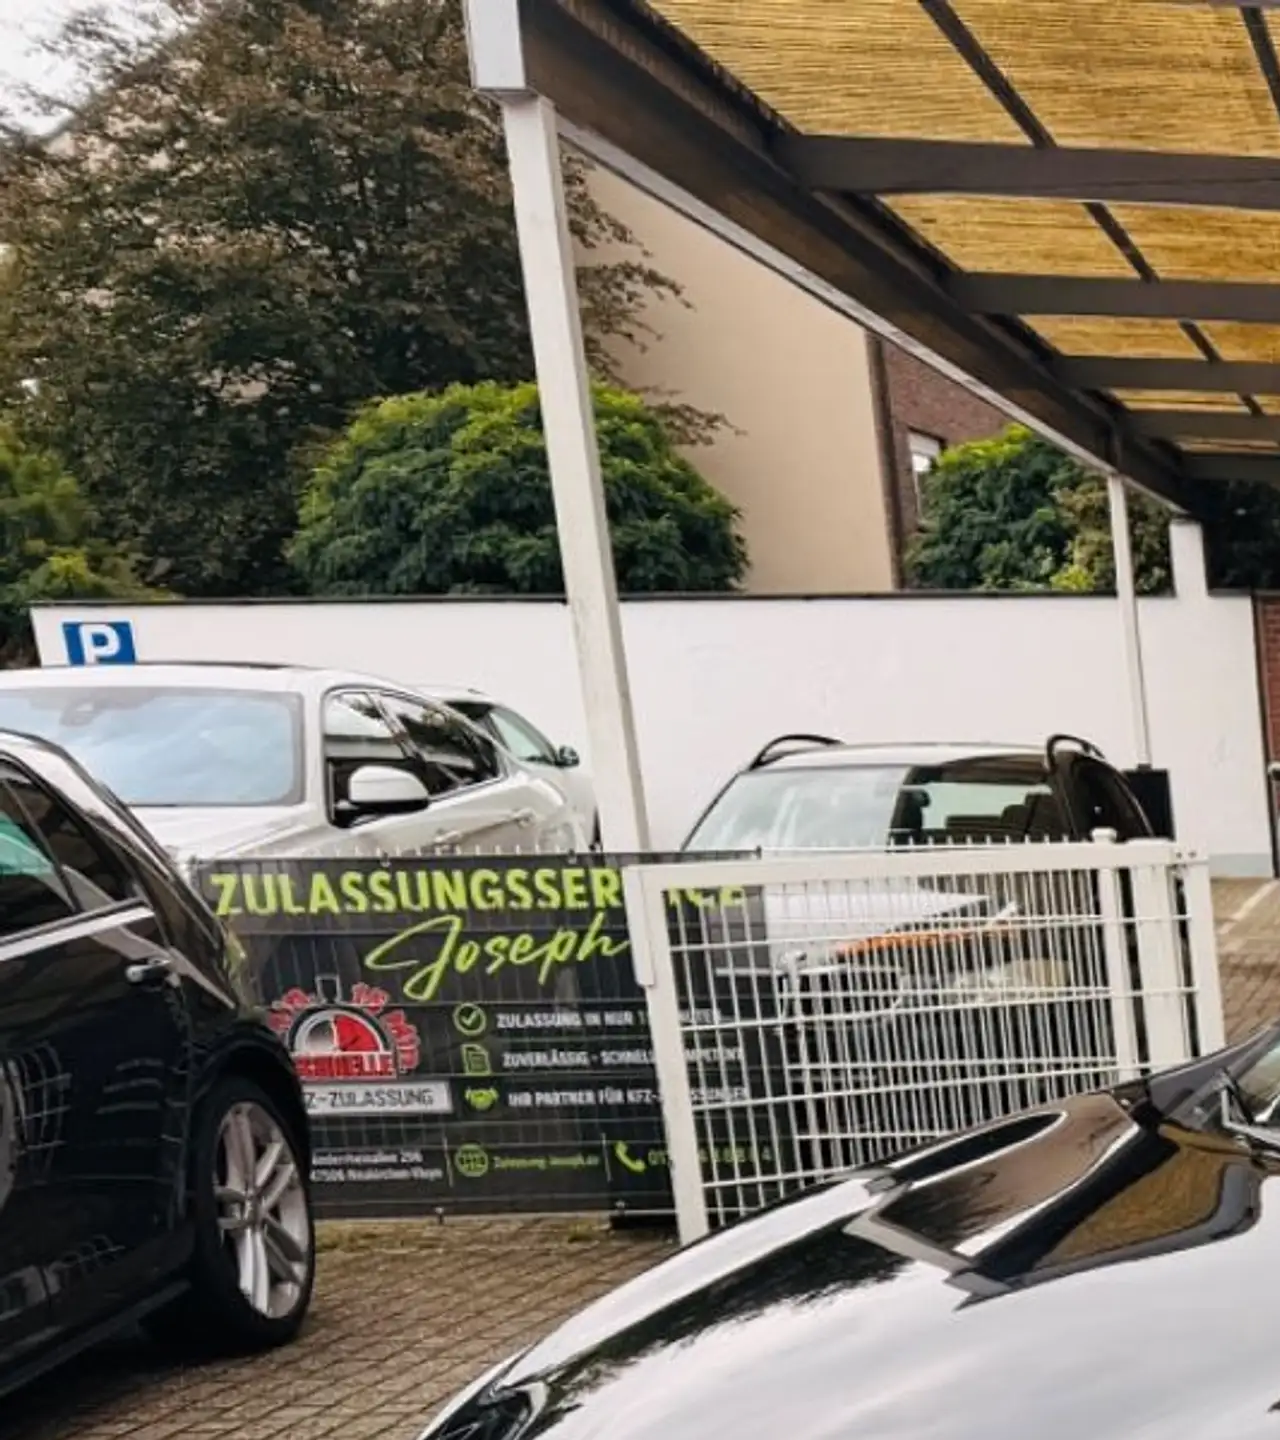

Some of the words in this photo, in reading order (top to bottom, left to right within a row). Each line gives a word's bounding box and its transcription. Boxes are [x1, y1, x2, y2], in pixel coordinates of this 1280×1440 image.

[79, 622, 121, 665] P
[209, 867, 747, 916] ZULASSUNGSSER
[366, 913, 630, 1000] Joseph
[303, 1087, 434, 1110] Z-ZULASSUNG
